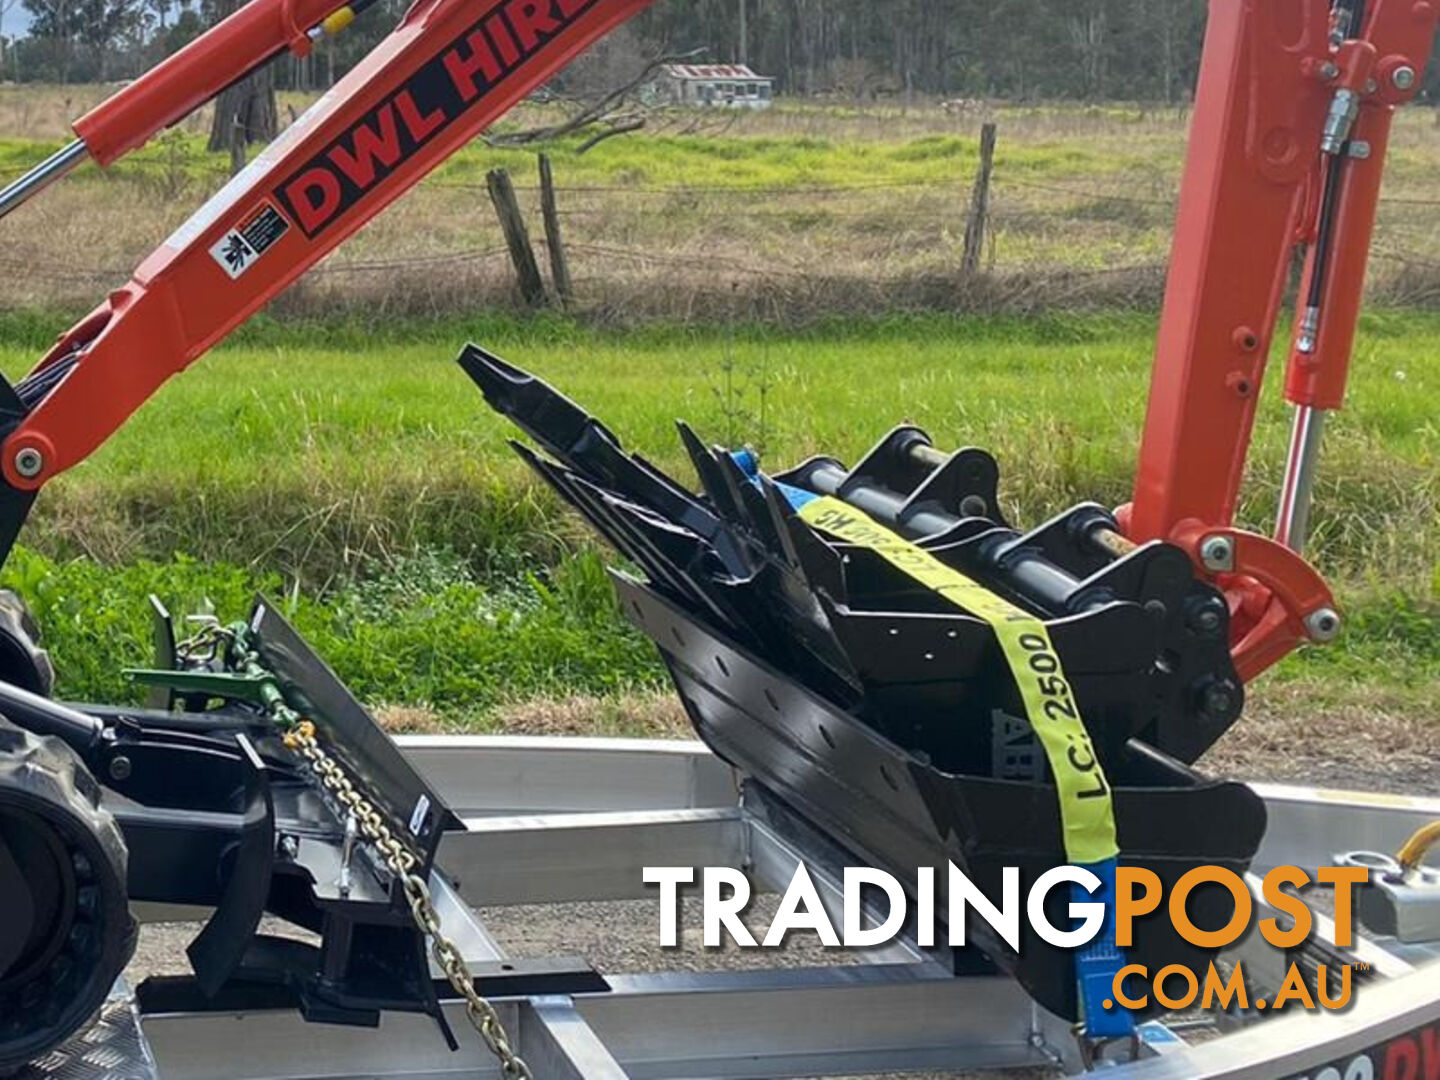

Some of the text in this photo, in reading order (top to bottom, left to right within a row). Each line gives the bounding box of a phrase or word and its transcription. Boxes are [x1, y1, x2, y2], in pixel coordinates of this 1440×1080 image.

[285, 88, 446, 234] DWL
[1019, 633, 1108, 799] LC: 2500
